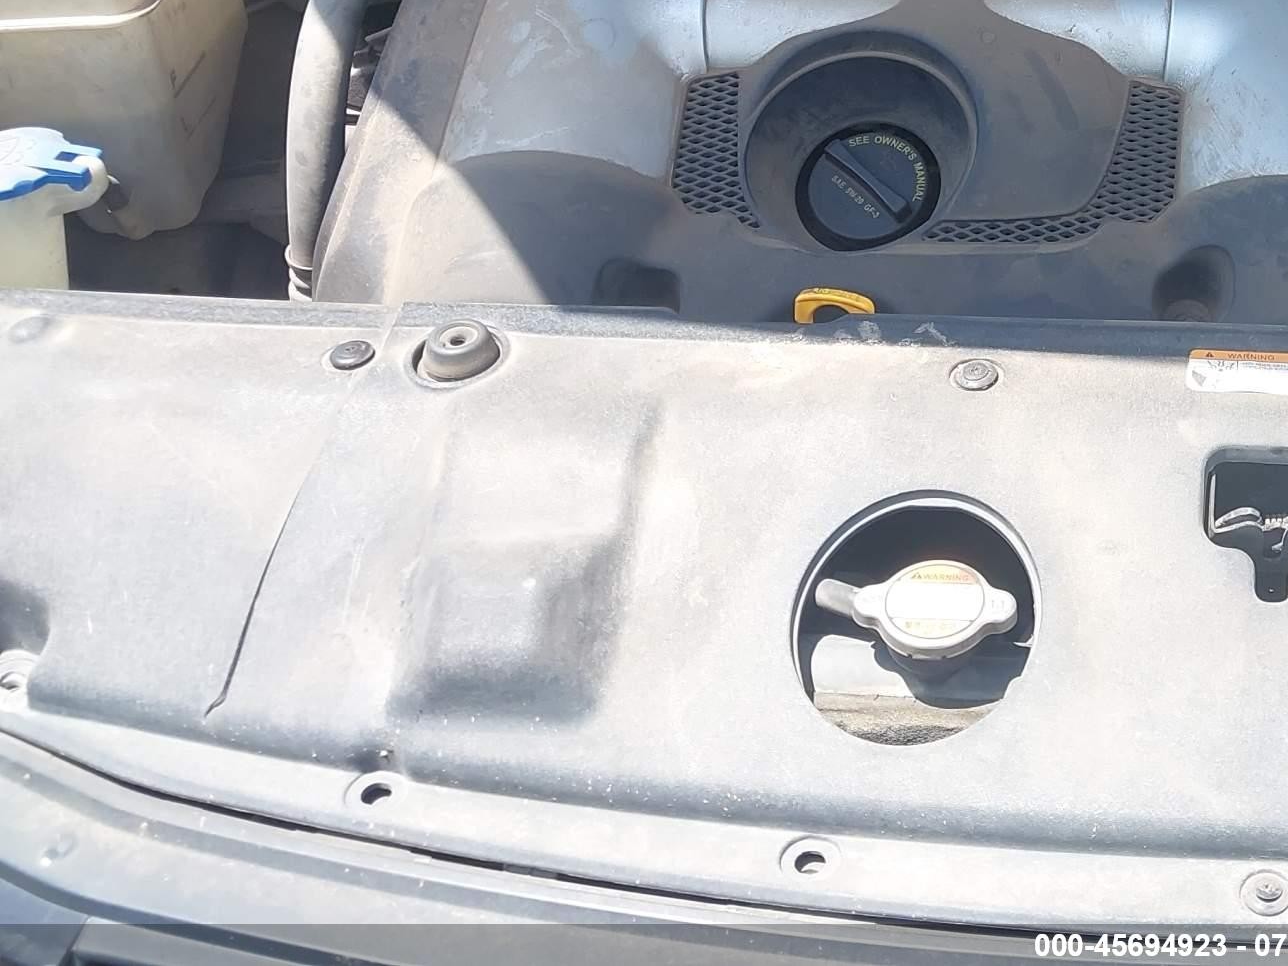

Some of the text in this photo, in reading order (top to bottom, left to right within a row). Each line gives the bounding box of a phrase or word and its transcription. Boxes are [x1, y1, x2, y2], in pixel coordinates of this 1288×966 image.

[848, 135, 926, 202] SEE OWNER'S MANUAL
[831, 175, 848, 189] SAE
[1227, 352, 1275, 361] WARNING
